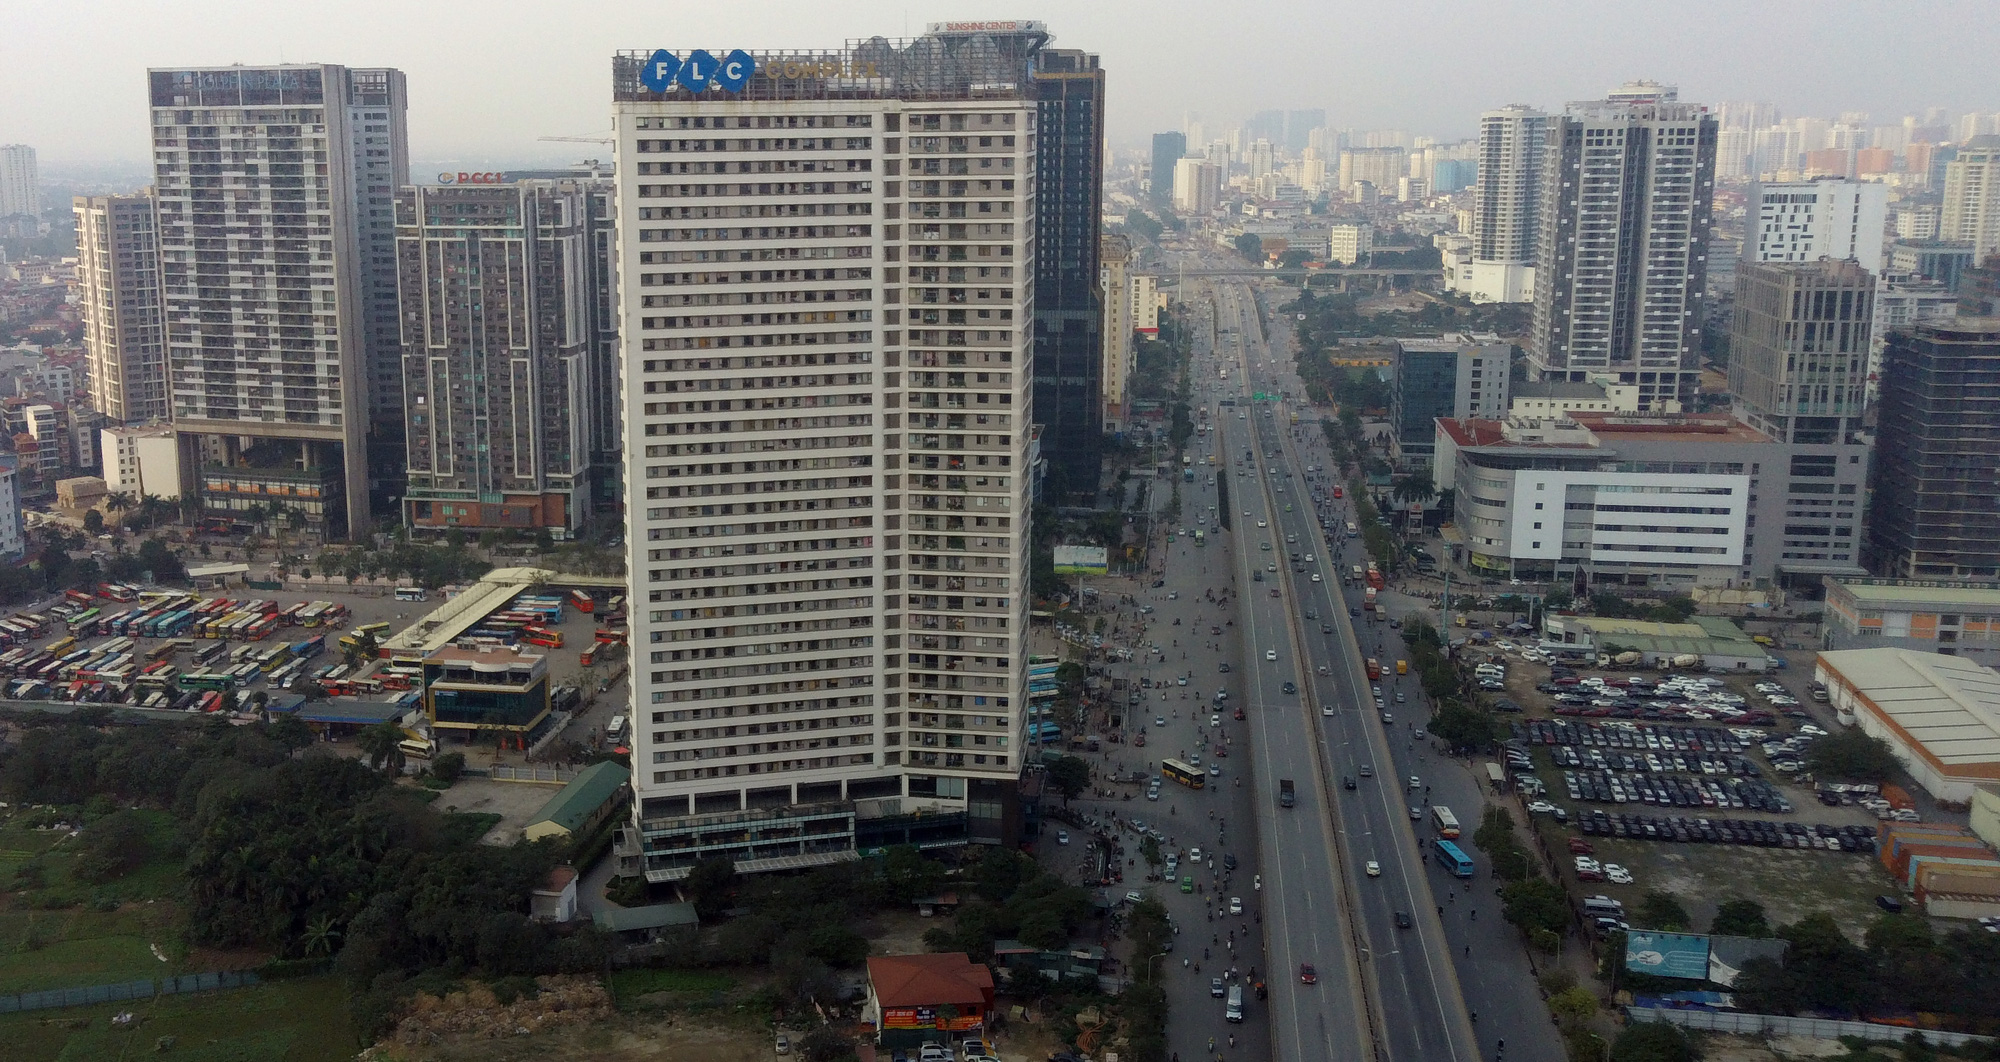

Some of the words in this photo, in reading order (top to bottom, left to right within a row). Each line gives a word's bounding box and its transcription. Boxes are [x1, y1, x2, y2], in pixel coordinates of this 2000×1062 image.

[946, 22, 985, 31] SUNSHINE
[986, 21, 1016, 30] CENTER
[656, 62, 743, 80] FLC
[765, 61, 877, 79] COMPLEX
[193, 73, 253, 90] DOLPHIN
[258, 73, 299, 89] PLAZA
[457, 172, 502, 184] PCC1
